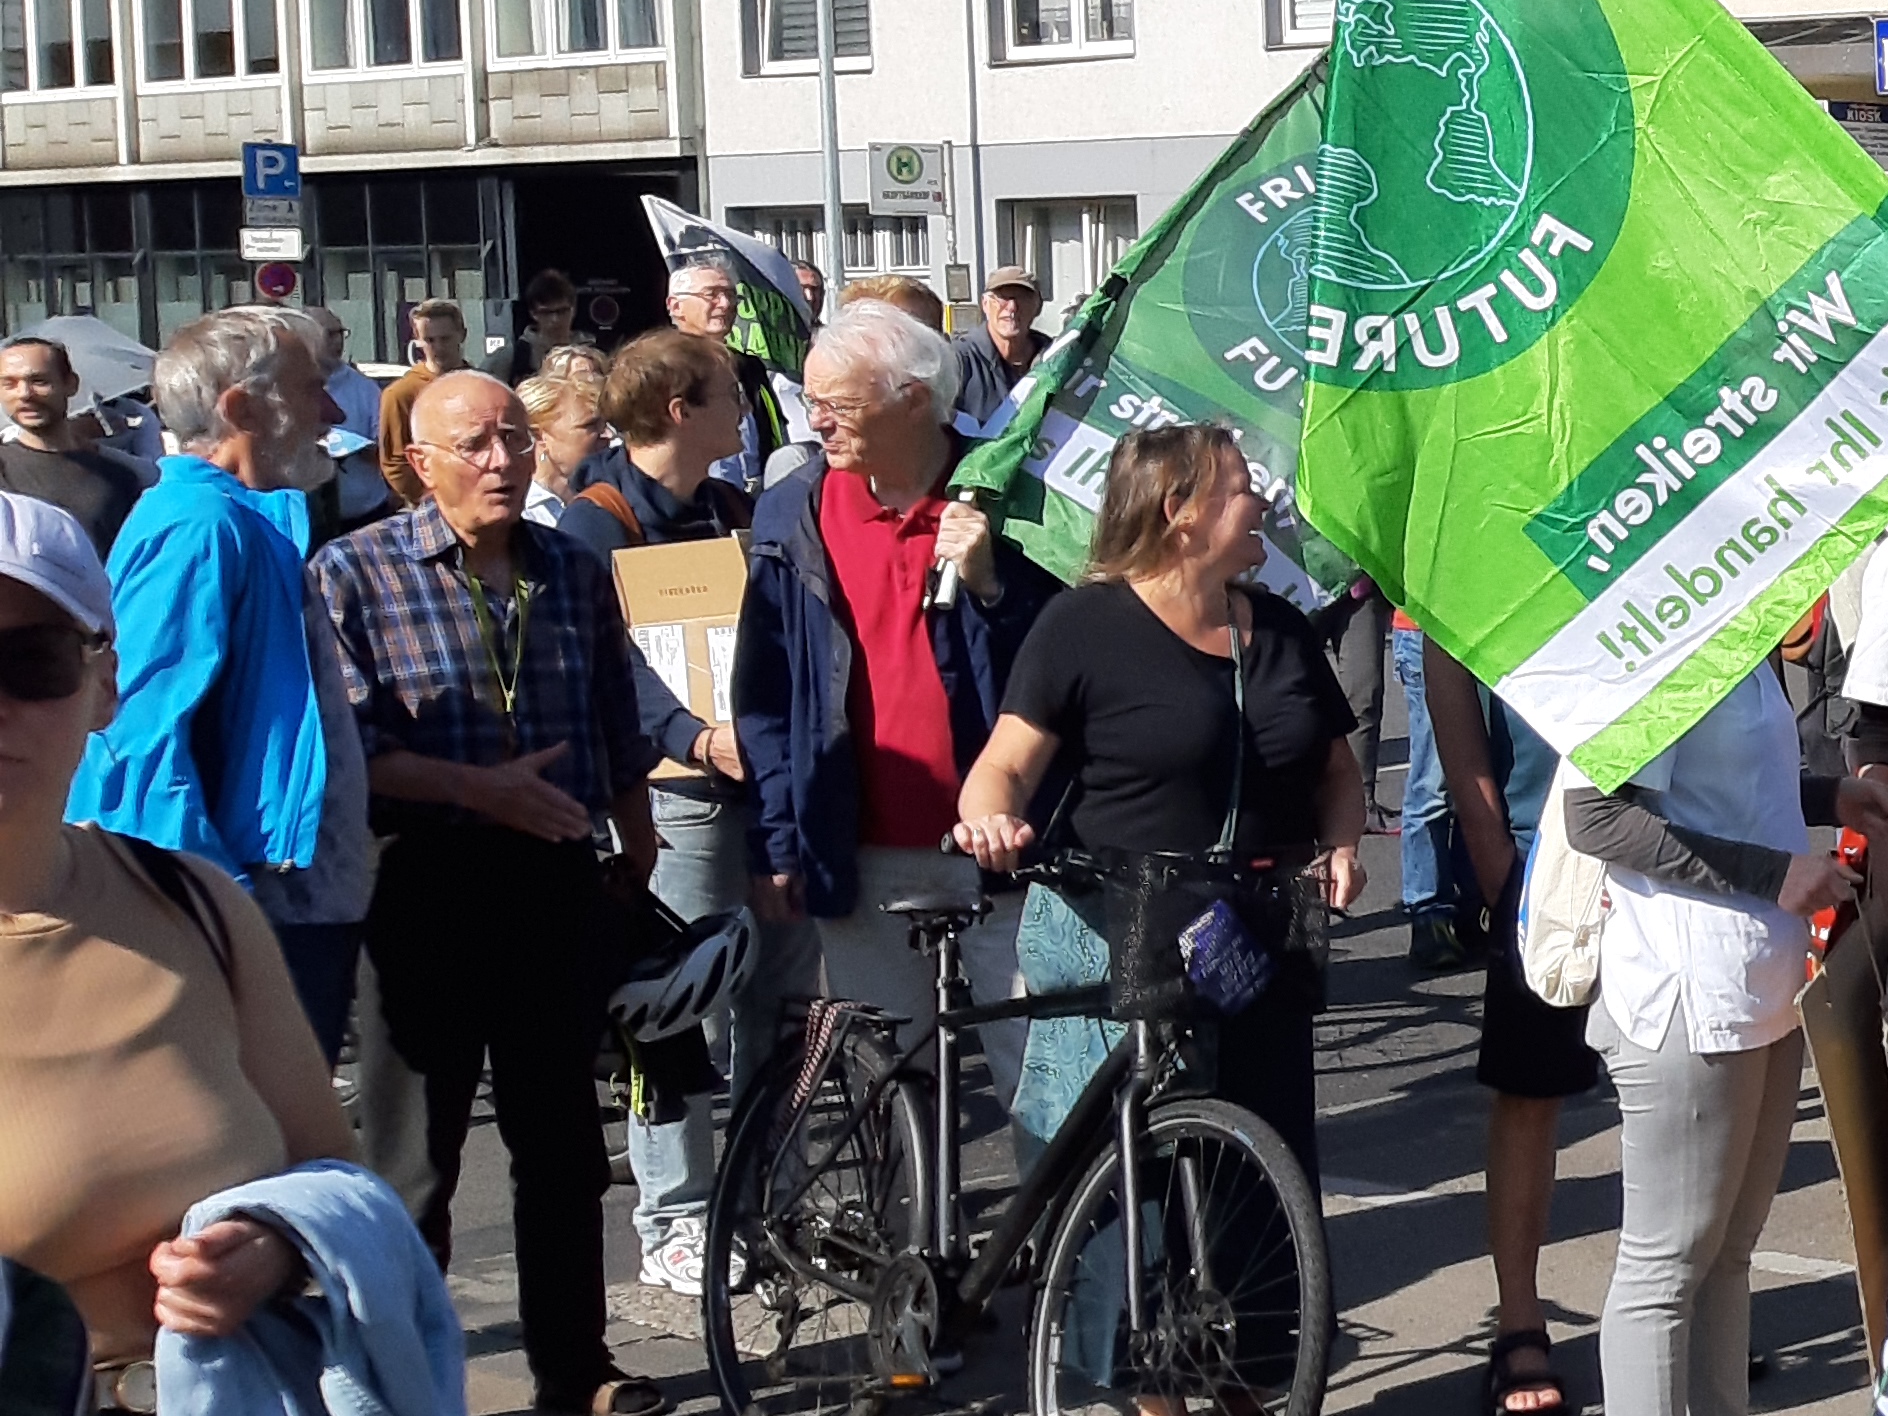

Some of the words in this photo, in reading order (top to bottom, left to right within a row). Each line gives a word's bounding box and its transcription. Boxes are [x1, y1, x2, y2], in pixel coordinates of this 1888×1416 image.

[1846, 109, 1882, 122] KIOSK
[1235, 164, 1316, 224] FRI
[1223, 335, 1304, 407] FU
